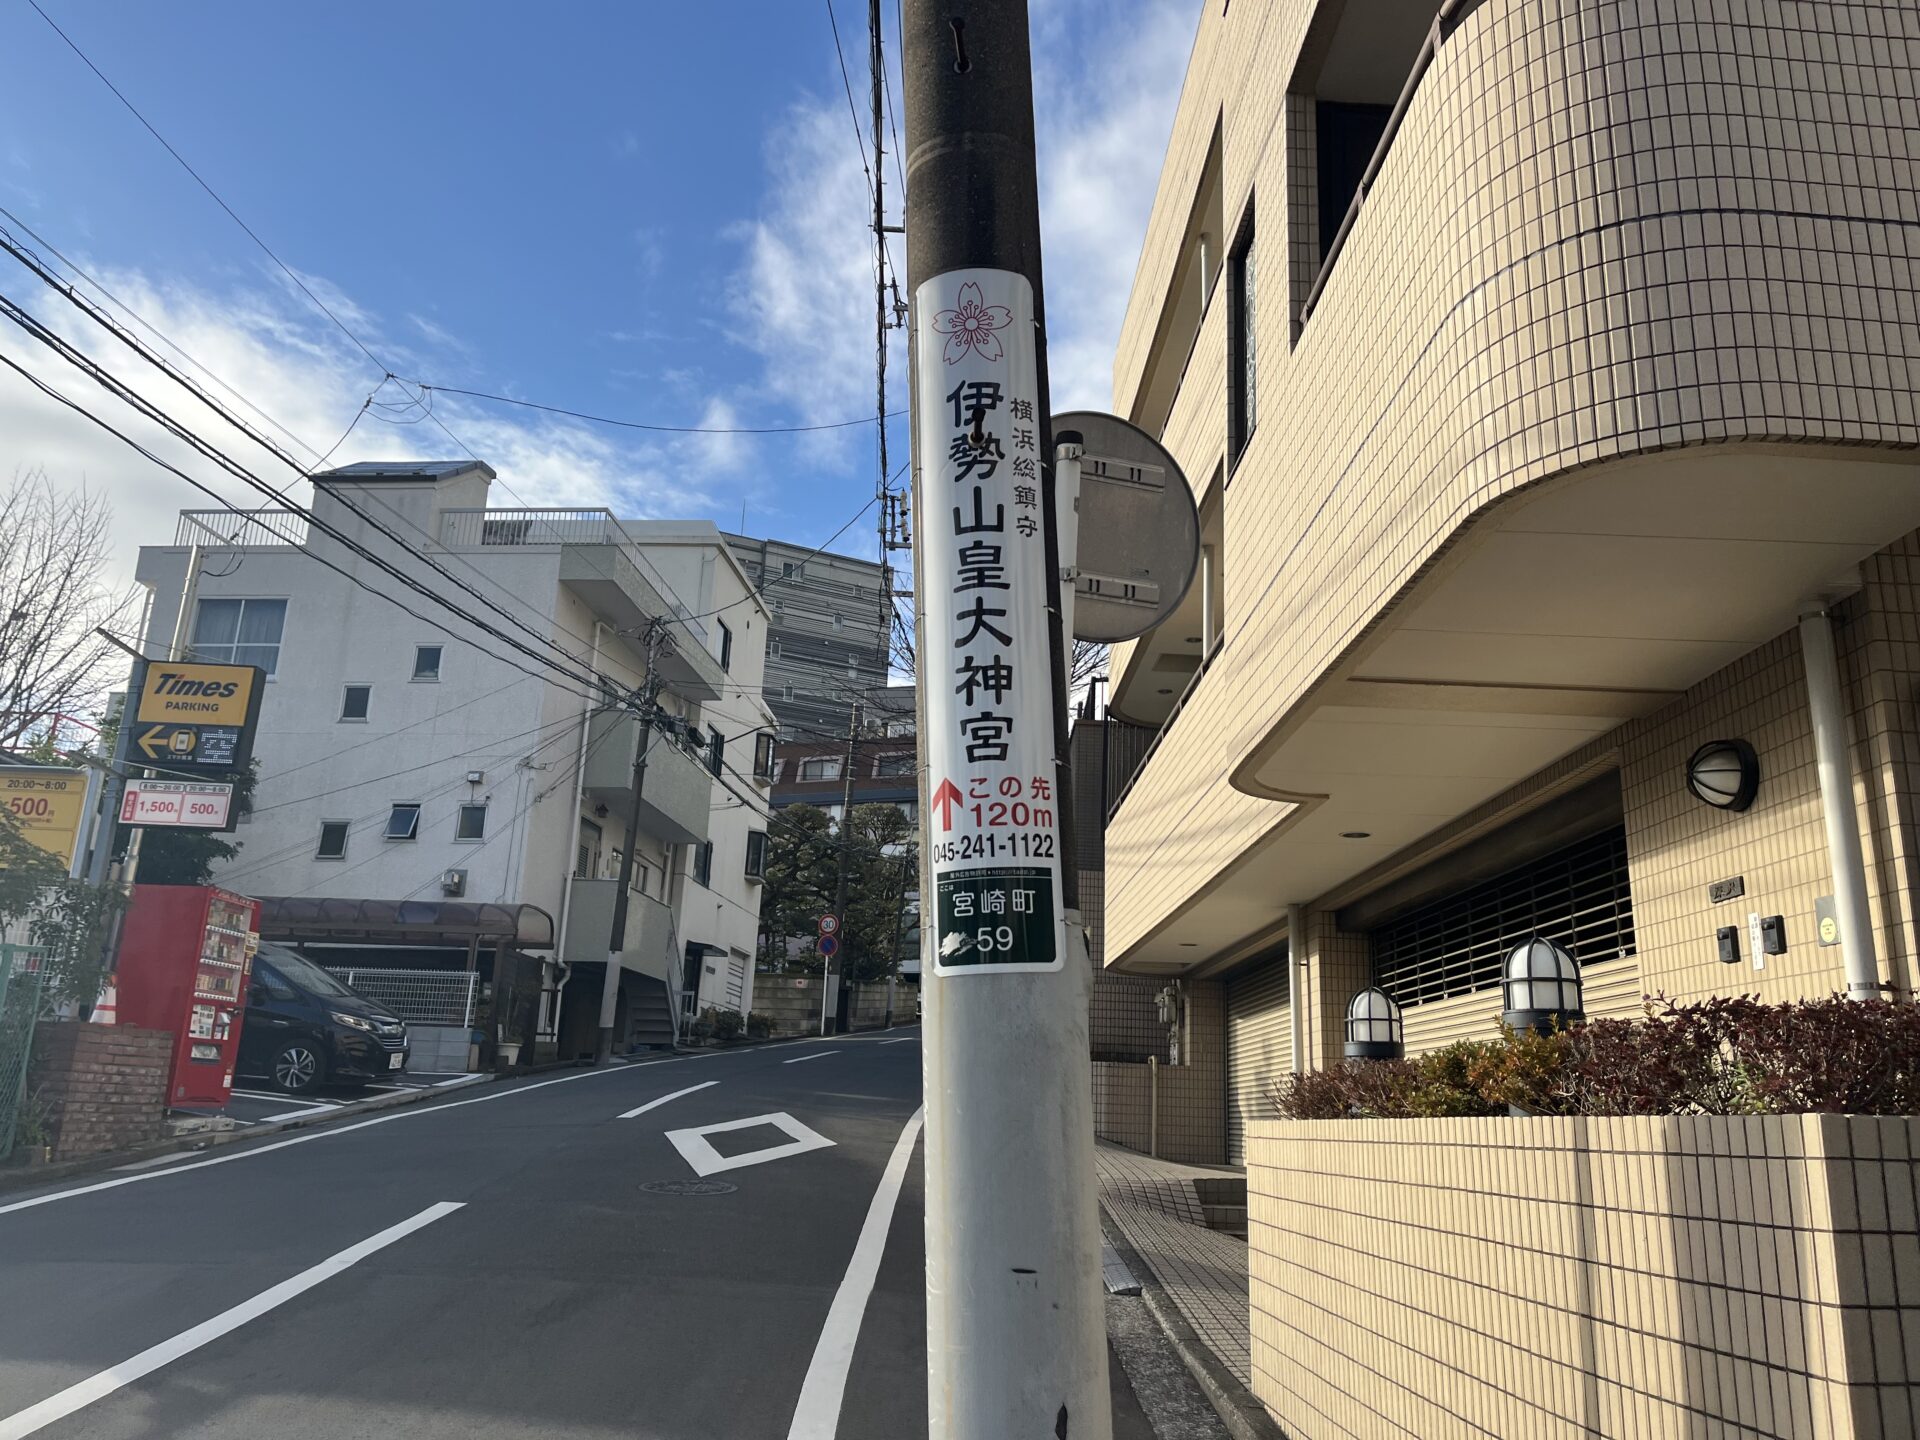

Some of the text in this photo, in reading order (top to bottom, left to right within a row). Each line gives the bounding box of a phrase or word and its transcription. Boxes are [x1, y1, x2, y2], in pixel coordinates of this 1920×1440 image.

[1010, 397, 1038, 538] 横浜総鎮守
[946, 379, 1014, 764] 伊勢山皇大神宮
[154, 673, 239, 698] Times
[165, 701, 219, 712] PARKING
[196, 729, 238, 764] 空
[969, 776, 1051, 801] この先
[970, 802, 1053, 828] 120m
[933, 832, 1054, 864] 045-241-1122
[952, 888, 1036, 917] 宮崎町
[823, 920, 834, 929] 30
[976, 926, 1014, 952] 59
